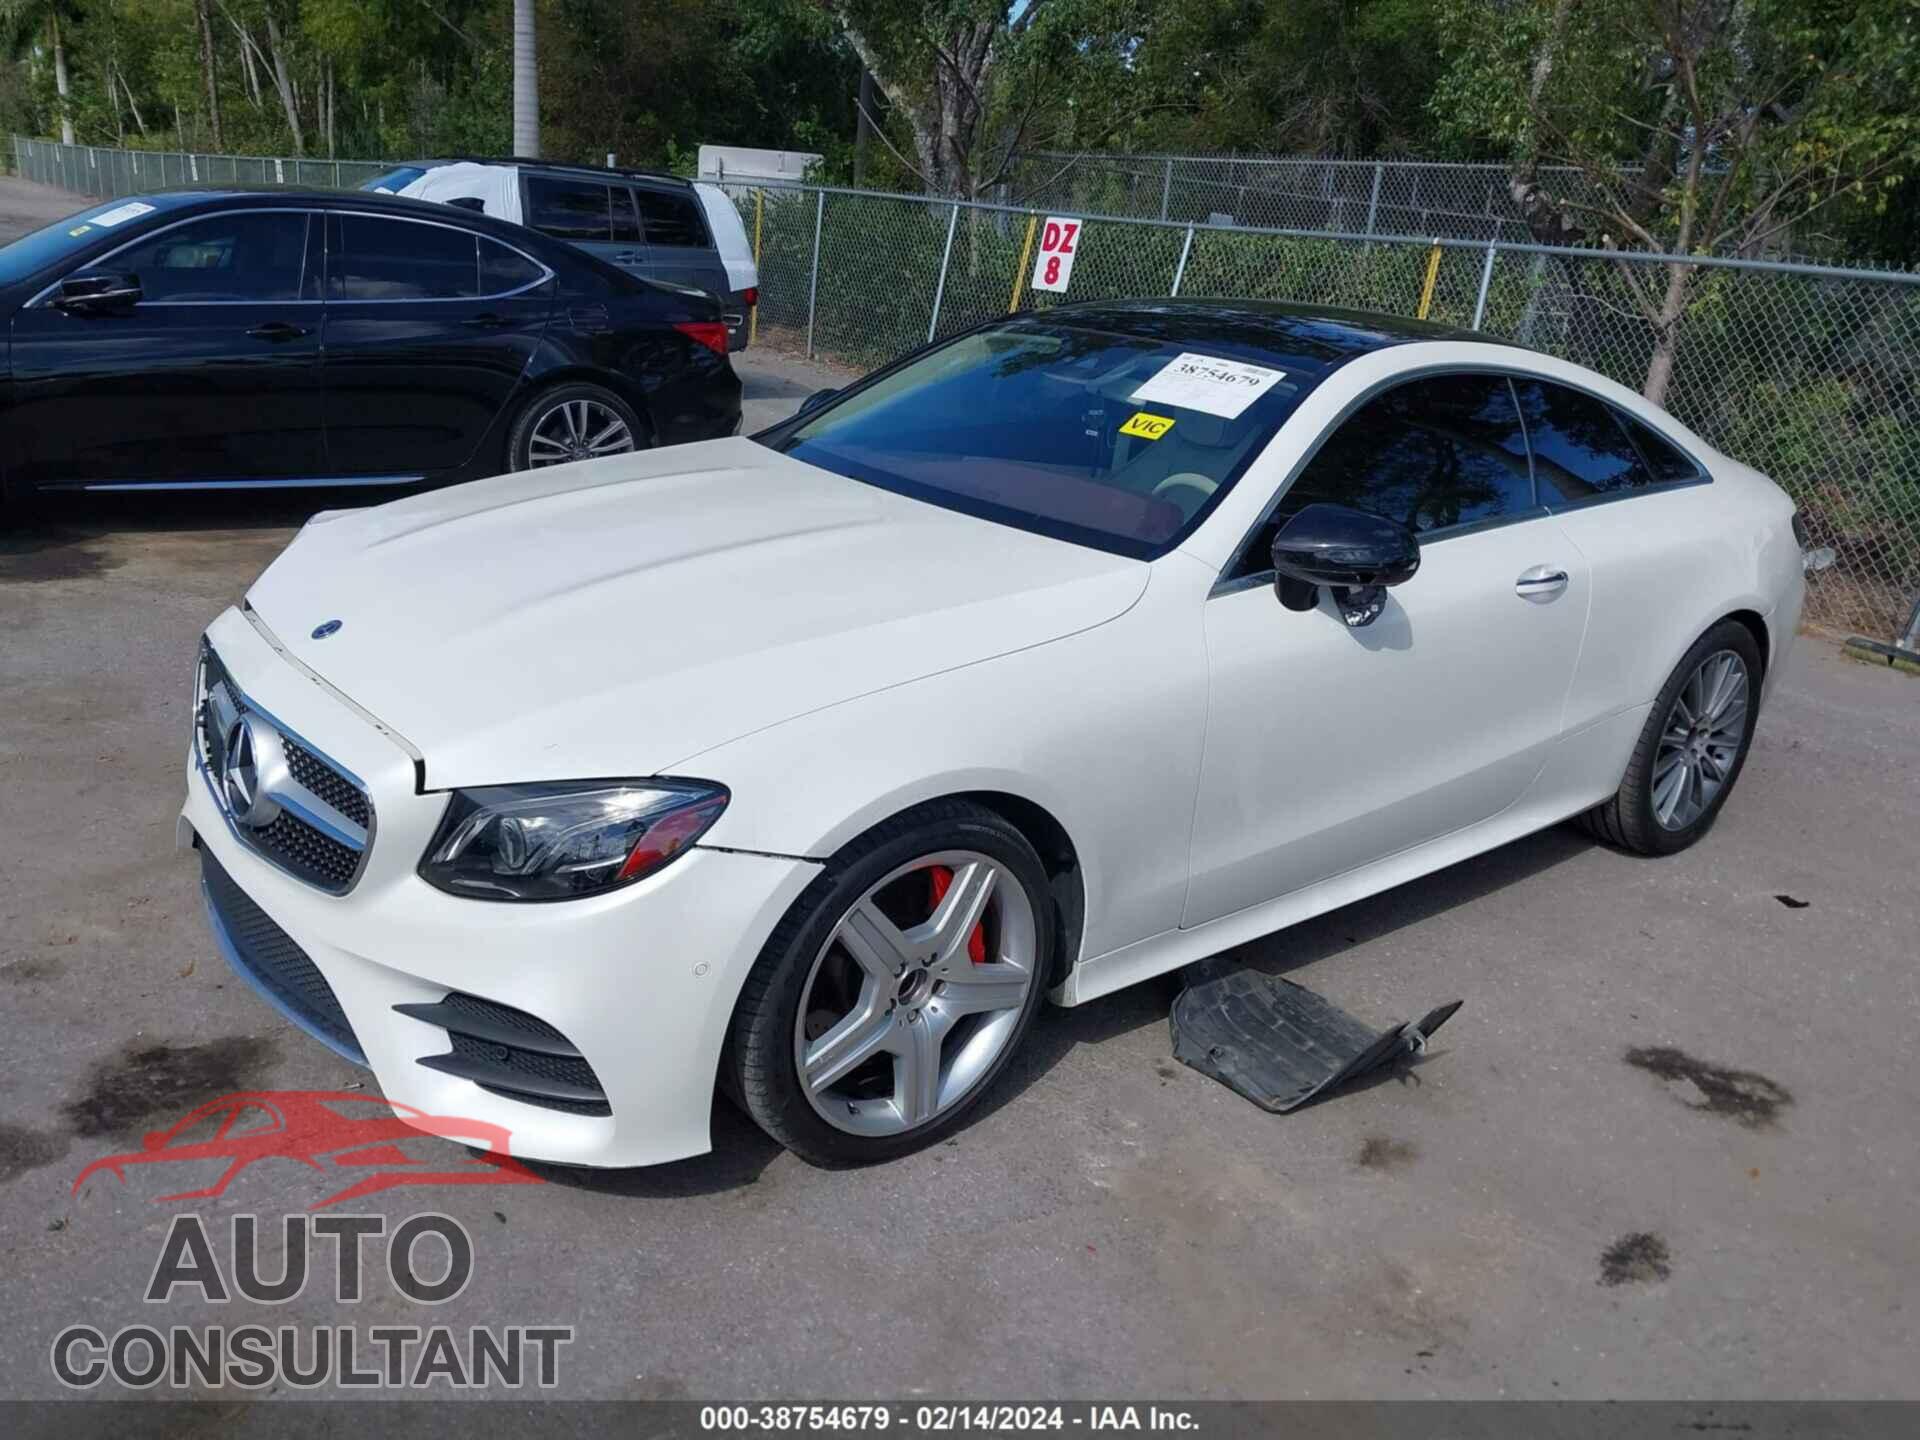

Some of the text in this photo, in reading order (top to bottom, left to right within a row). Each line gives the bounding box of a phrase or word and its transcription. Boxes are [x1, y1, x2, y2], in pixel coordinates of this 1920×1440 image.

[1042, 222, 1079, 254] DZ
[1044, 255, 1061, 285] 8
[1173, 362, 1261, 387] 38754679
[1131, 417, 1167, 434] VIC
